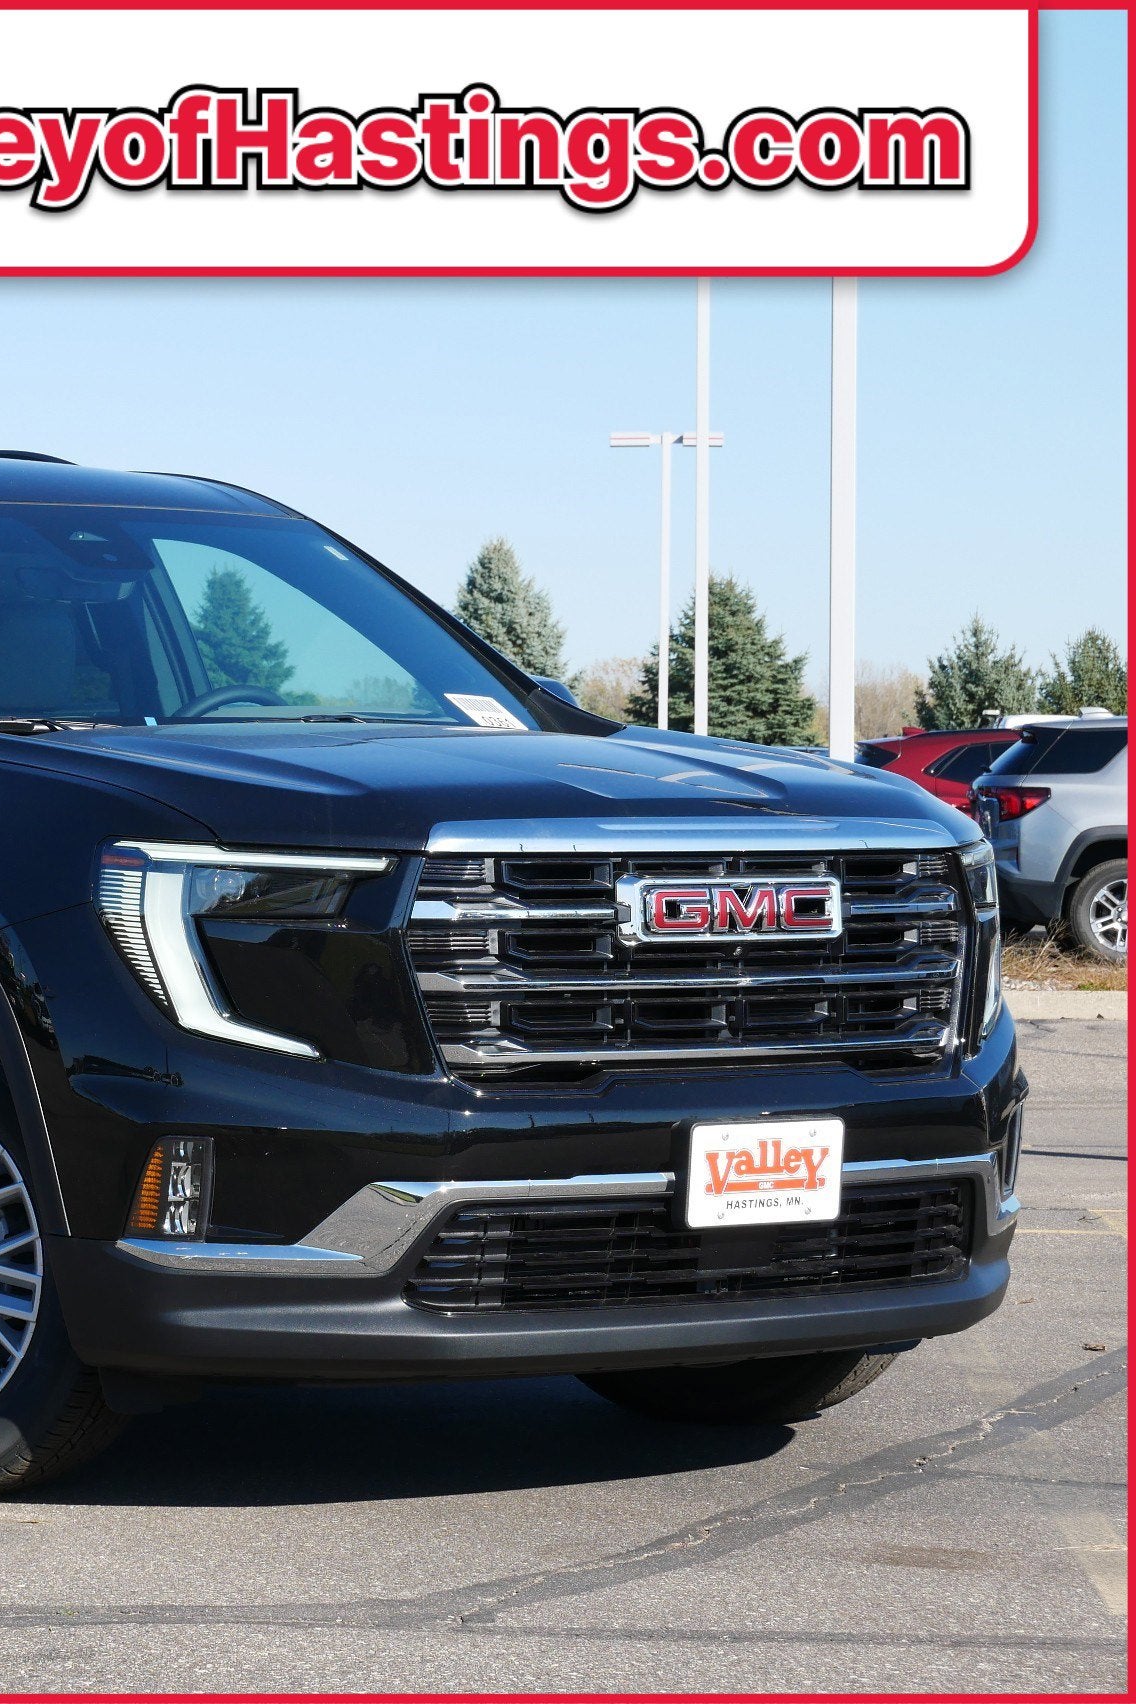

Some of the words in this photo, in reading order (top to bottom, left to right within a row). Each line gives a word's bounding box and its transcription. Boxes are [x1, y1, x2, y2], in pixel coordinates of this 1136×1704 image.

[648, 886, 834, 932] GMC
[758, 1180, 775, 1190] GMC
[725, 1199, 782, 1210] HASTINGS,
[786, 1196, 804, 1206] MN.
